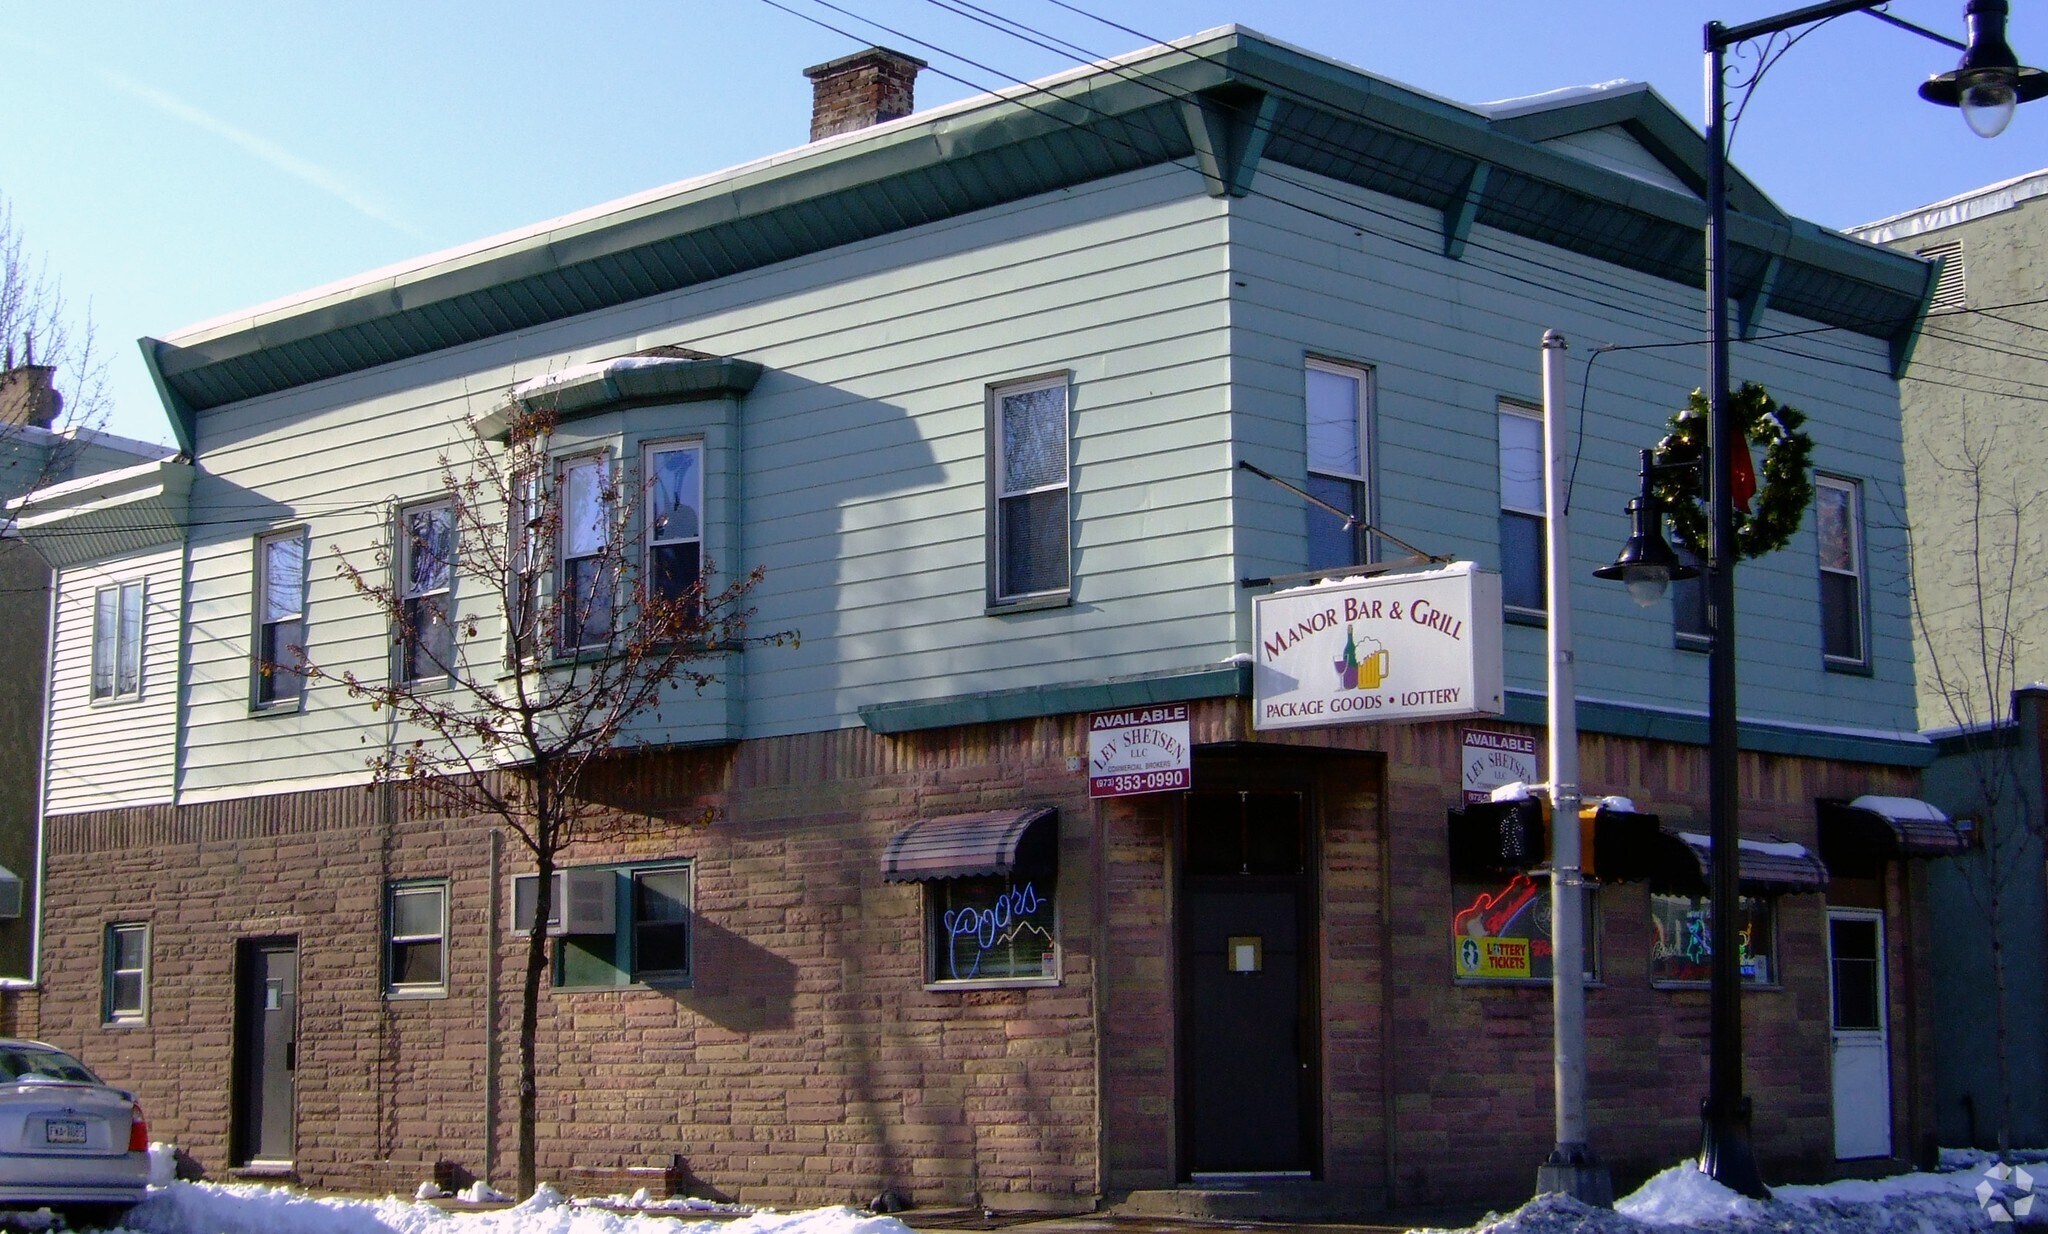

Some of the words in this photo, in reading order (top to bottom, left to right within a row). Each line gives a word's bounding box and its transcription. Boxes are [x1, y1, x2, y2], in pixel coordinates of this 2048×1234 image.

[1389, 601, 1403, 620] &
[1266, 699, 1324, 719] PACKAGE
[1330, 694, 1382, 712] GOODS
[1401, 687, 1460, 707] LOTTERY
[1093, 706, 1185, 729] AVAILABLE
[1465, 732, 1533, 752] AVAILABLE
[1094, 738, 1118, 770] LEV
[1130, 748, 1148, 758] LLC
[1107, 763, 1143, 773] COMMERCIAL
[1145, 761, 1171, 770] BROKERS
[1096, 777, 1115, 788] (973)
[1115, 770, 1183, 792] 353-0990
[944, 881, 1046, 980] Coors
[1487, 942, 1526, 956] LOTTERY
[1489, 956, 1526, 969] TICKETS
